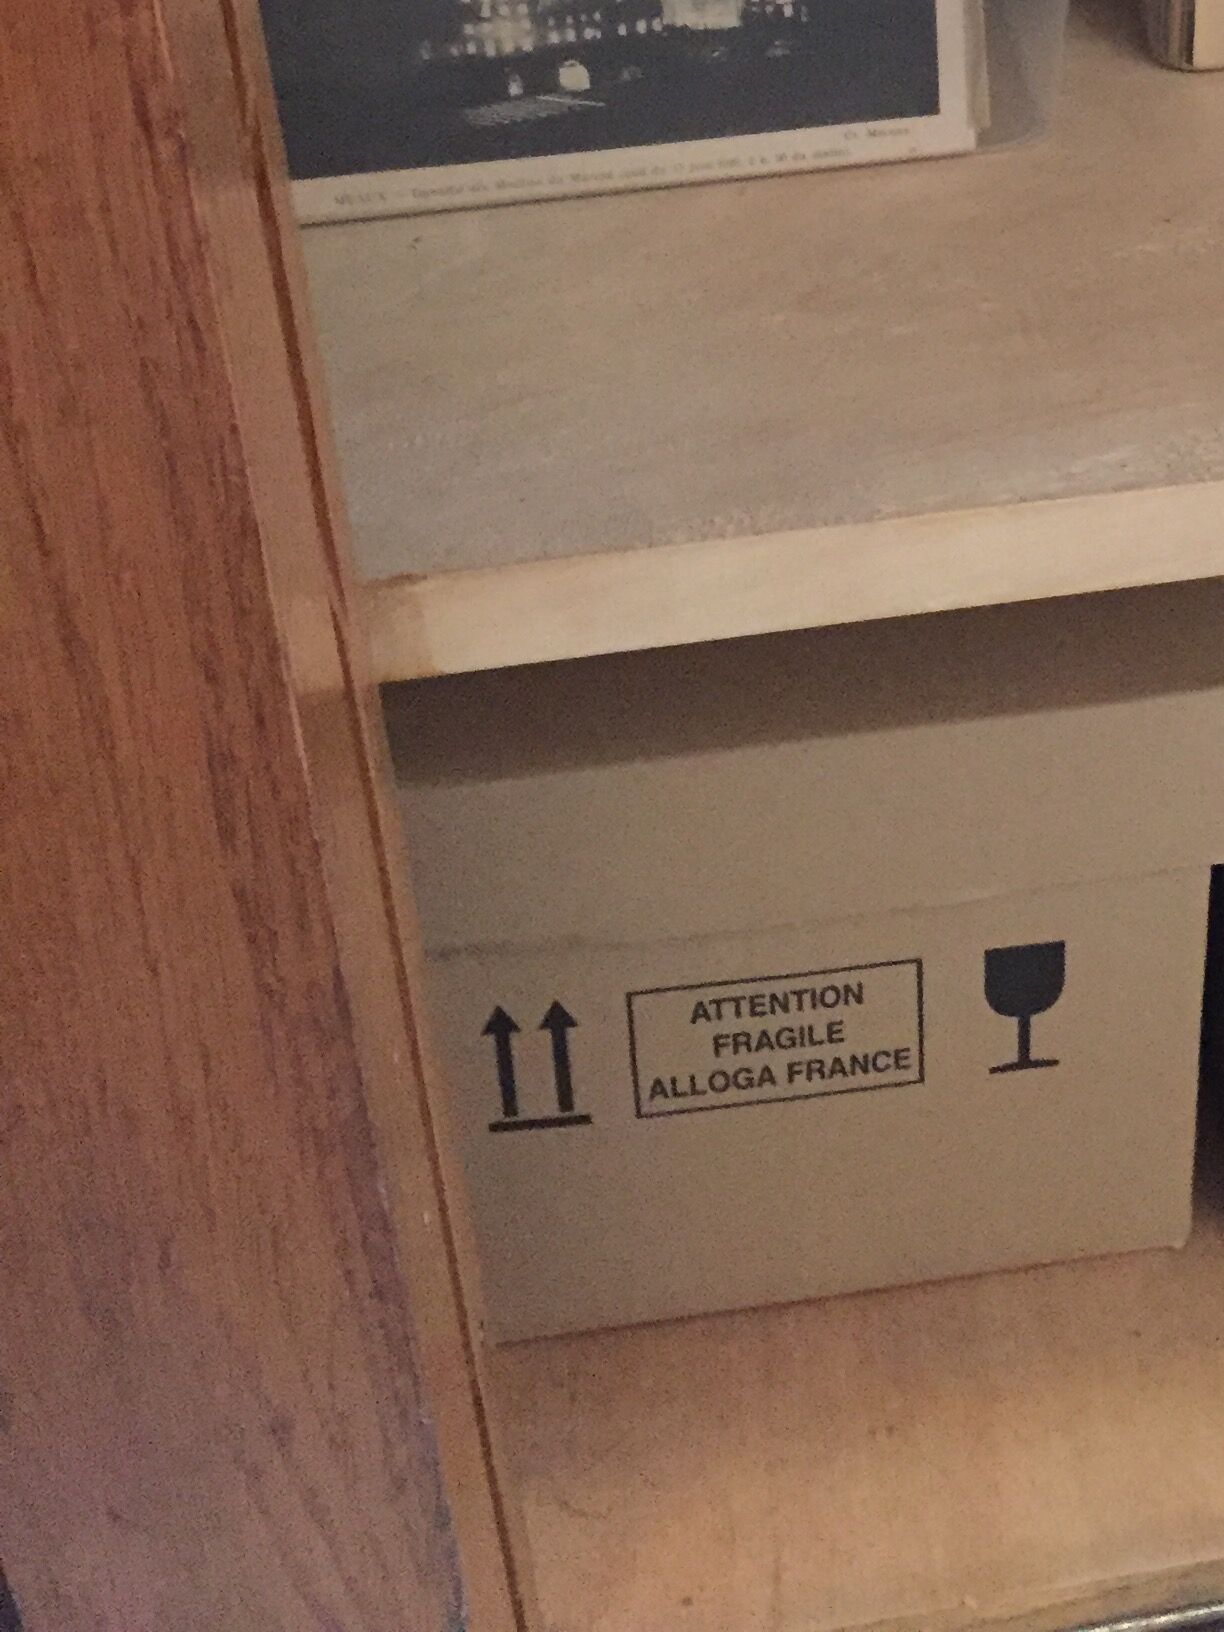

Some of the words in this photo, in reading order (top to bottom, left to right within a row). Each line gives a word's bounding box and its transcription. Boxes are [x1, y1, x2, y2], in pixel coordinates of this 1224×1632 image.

[690, 980, 865, 1025] ATTENTION
[712, 1020, 846, 1058] FRAGILE
[650, 1065, 777, 1103] ALLOGA
[786, 1047, 912, 1085] FRANCE
